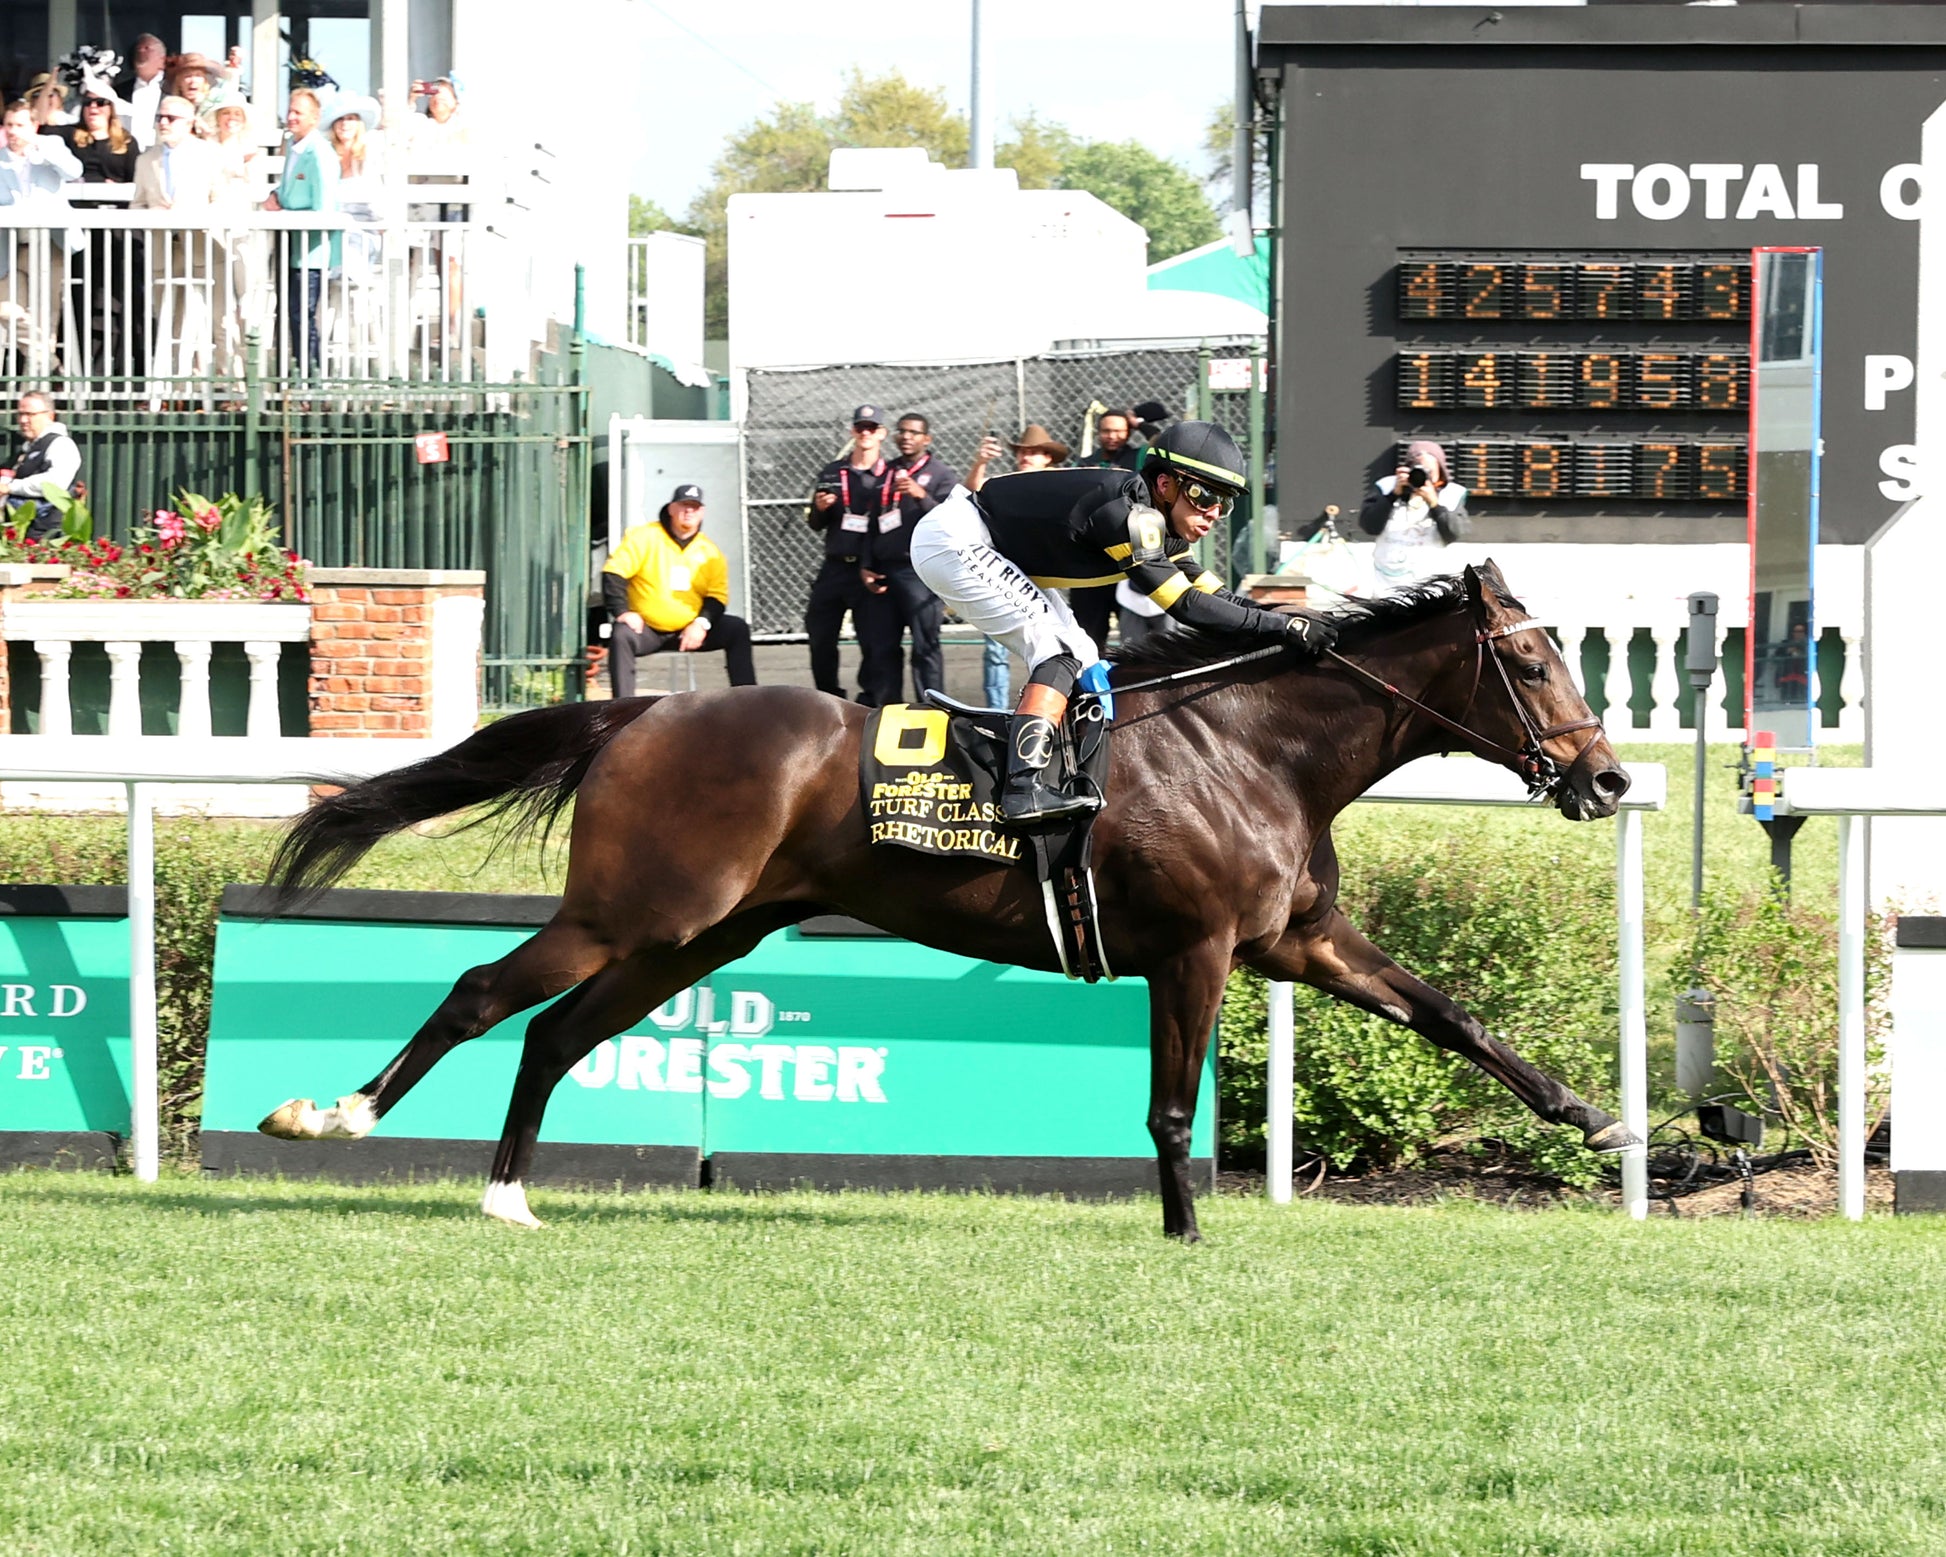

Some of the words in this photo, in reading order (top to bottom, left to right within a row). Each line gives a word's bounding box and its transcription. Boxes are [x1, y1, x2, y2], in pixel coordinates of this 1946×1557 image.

[1580, 163, 1844, 220] TOTAL
[1407, 263, 1739, 318] 425743
[1411, 353, 1738, 408] 141958
[1139, 512, 1162, 550] 6
[957, 549, 1037, 620] STEAKHOUSE
[874, 703, 950, 767] 6
[872, 782, 973, 800] FORESTER
[907, 771, 944, 786] OLD
[870, 797, 933, 818] TURF
[870, 820, 1023, 861] RHETORICAL
[567, 1035, 888, 1103] ORESTER
